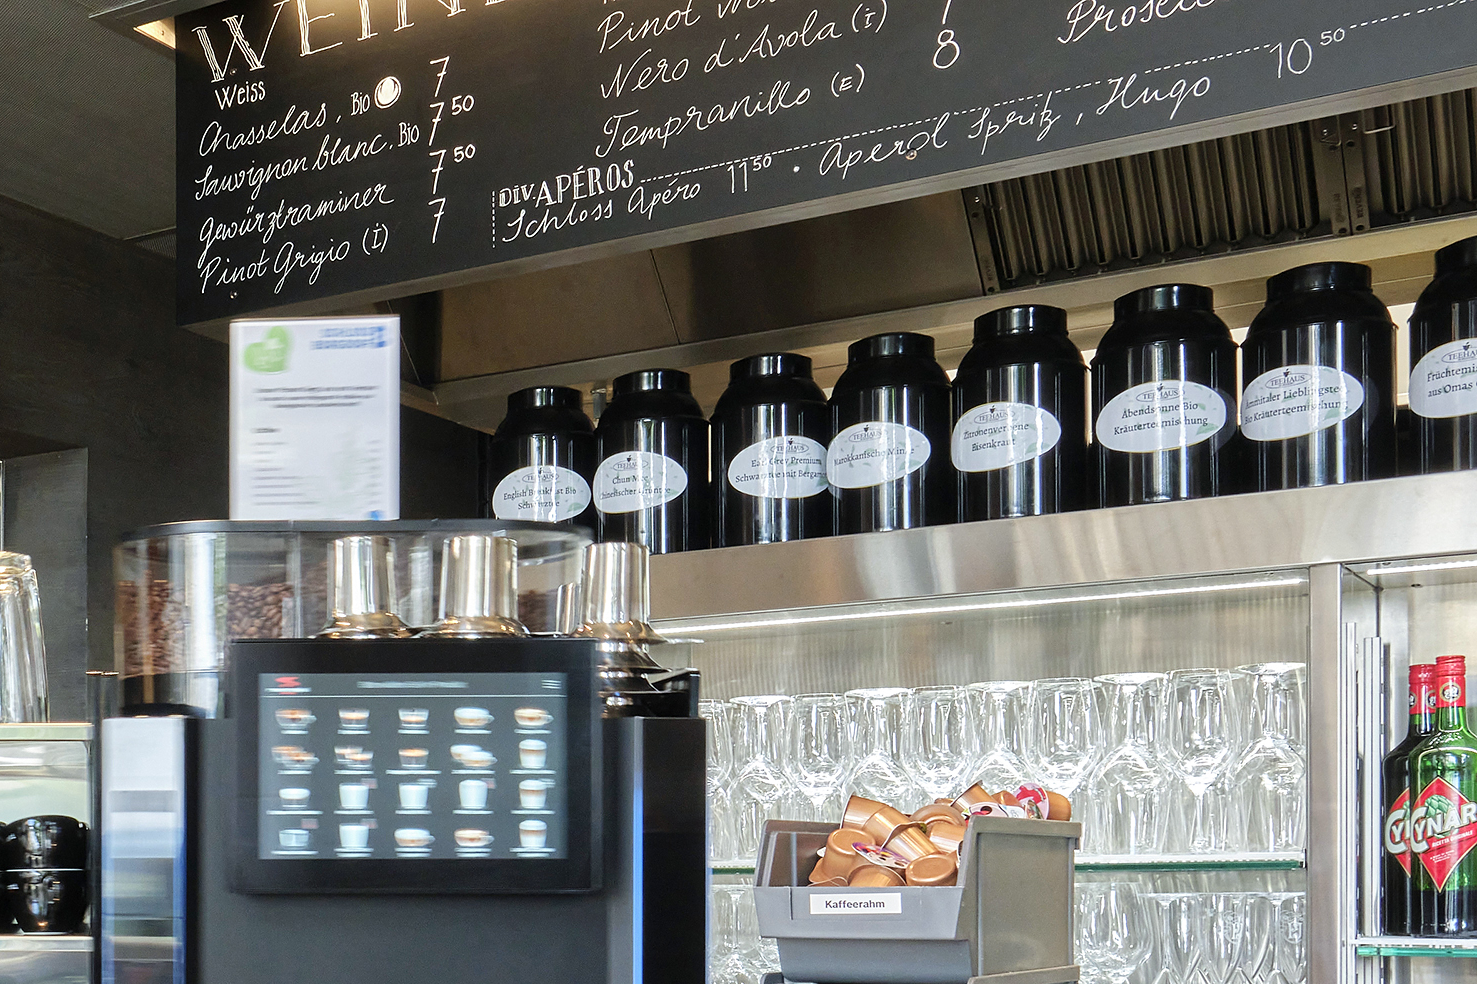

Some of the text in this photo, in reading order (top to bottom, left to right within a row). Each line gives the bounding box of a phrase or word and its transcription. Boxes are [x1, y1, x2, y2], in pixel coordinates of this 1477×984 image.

[597, 0, 701, 53] Pinot
[215, 81, 266, 110] Weiss
[351, 92, 370, 115] Bio
[429, 56, 450, 97] 7
[595, 30, 960, 157] Tempranillo (E) 8
[601, 49, 689, 98] Nero
[195, 160, 308, 200] Sauvignon
[398, 122, 419, 146] Bio
[502, 200, 613, 242] Schloss
[627, 178, 701, 220] Apéro
[819, 112, 951, 180] Aperol
[1096, 73, 1210, 120] Hugo
[1269, 38, 1312, 79] 10
[1320, 28, 1345, 46] 50
[197, 183, 394, 268] Gewürztraminer
[200, 250, 270, 293] Pinot
[274, 239, 350, 294] Grigio
[429, 198, 446, 243] 7
[1427, 364, 1477, 382] Früchtemi
[1444, 382, 1473, 394] Omas
[791, 457, 822, 466] Premium
[1410, 801, 1477, 854] CYNAR
[825, 898, 886, 910] Kaffeerahm
